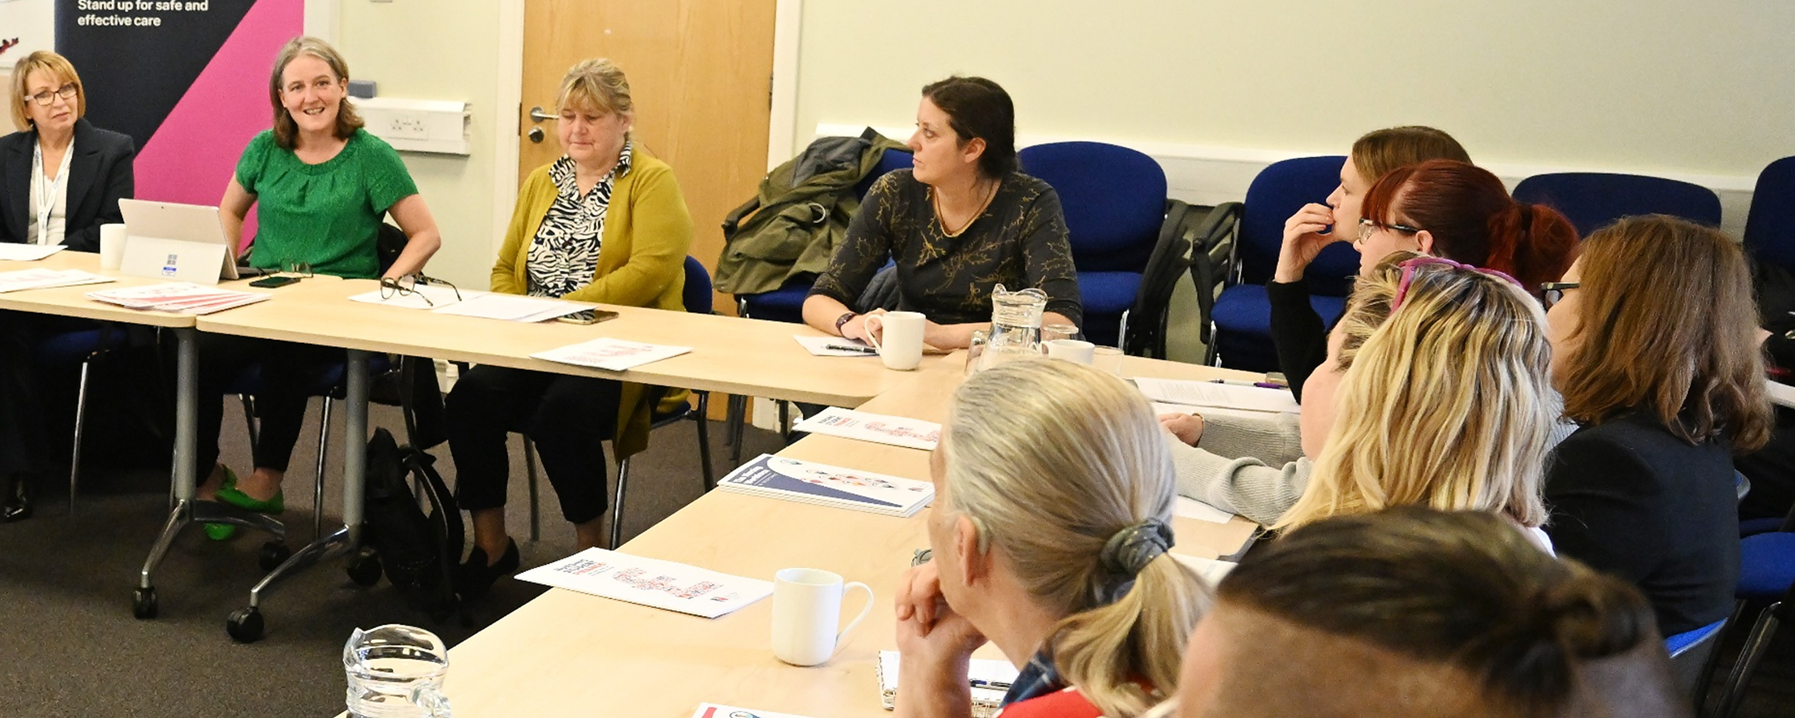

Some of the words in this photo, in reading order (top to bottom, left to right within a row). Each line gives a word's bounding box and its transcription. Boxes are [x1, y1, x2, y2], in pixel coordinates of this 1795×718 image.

[77, 0, 115, 11] Stand
[117, 1, 134, 13] up
[135, 0, 154, 11] for
[155, 0, 183, 11] safe
[184, 0, 209, 11] and
[77, 13, 133, 26] effective
[133, 16, 162, 27] care
